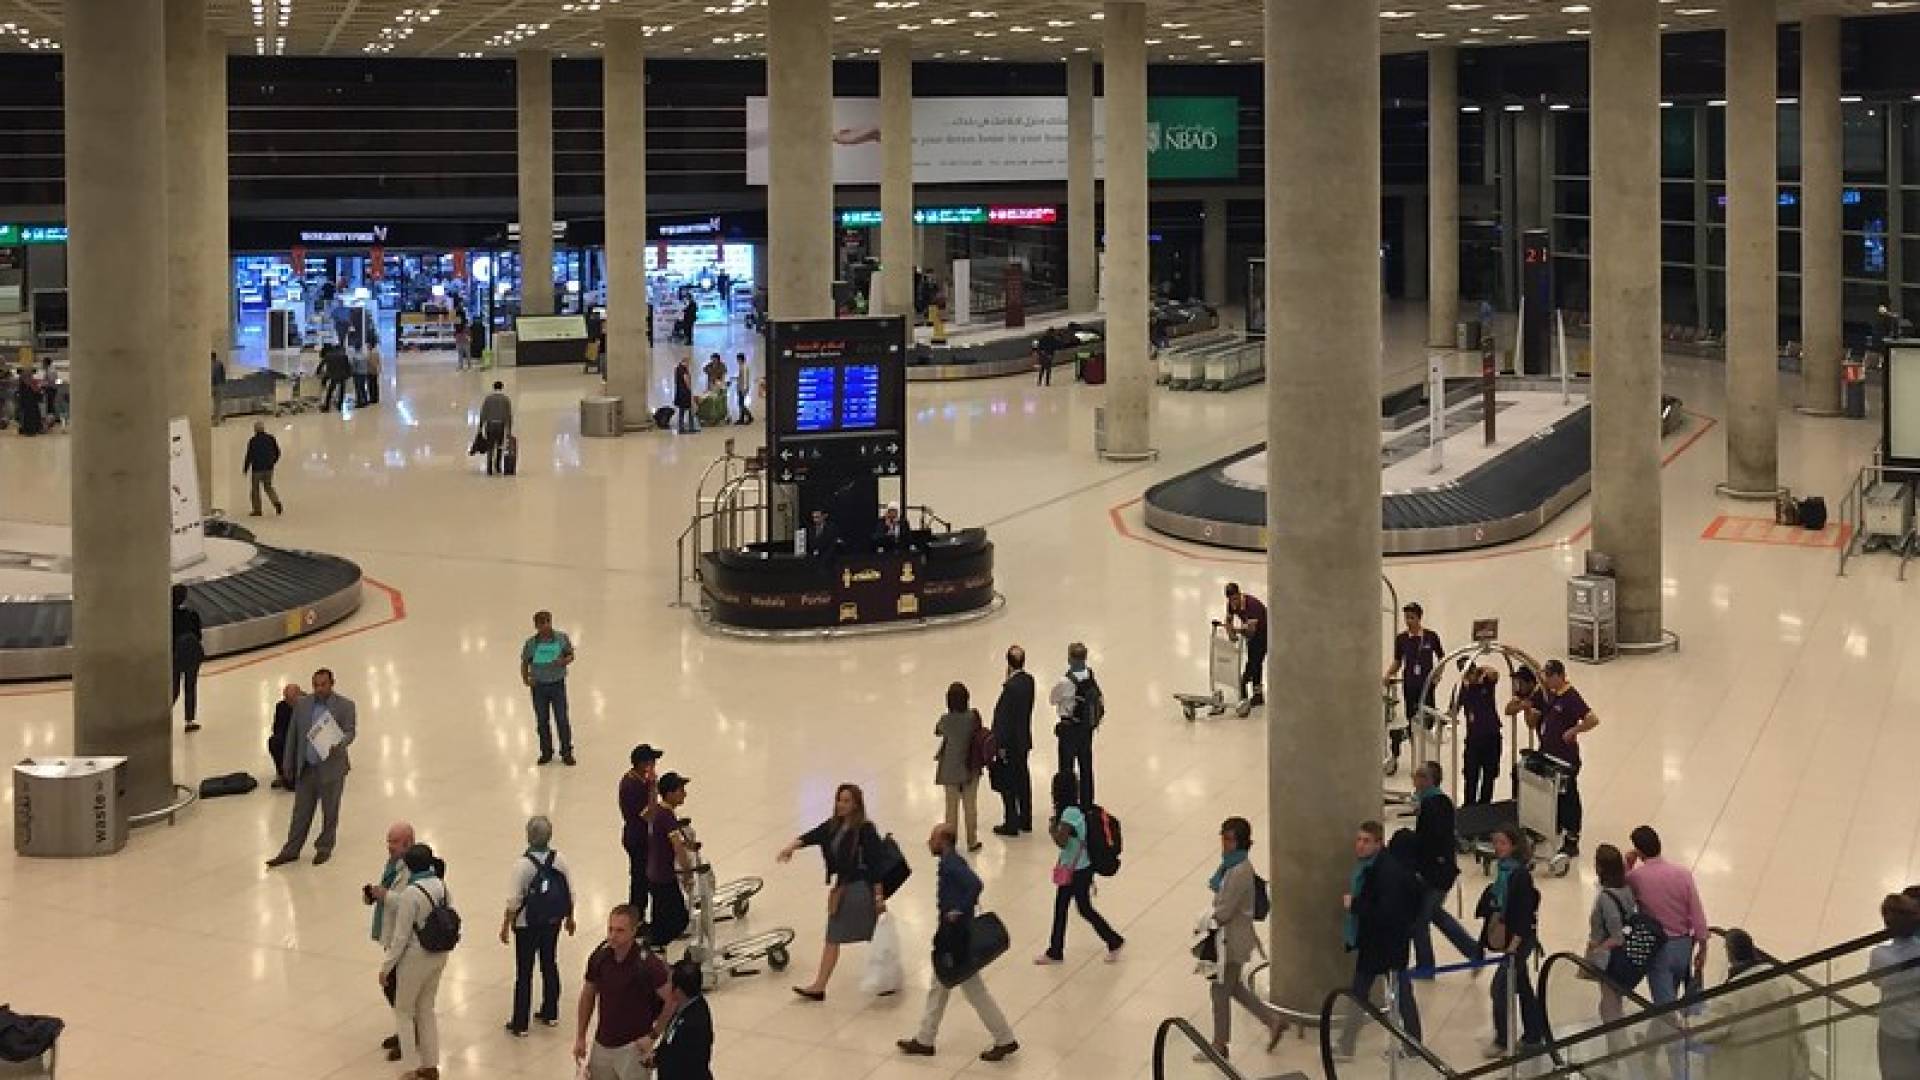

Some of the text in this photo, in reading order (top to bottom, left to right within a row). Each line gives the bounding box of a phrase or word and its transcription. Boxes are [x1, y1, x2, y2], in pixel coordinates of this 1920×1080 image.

[1166, 130, 1218, 150] NBAD
[1525, 247, 1547, 263] 21
[94, 793, 107, 843] waste
